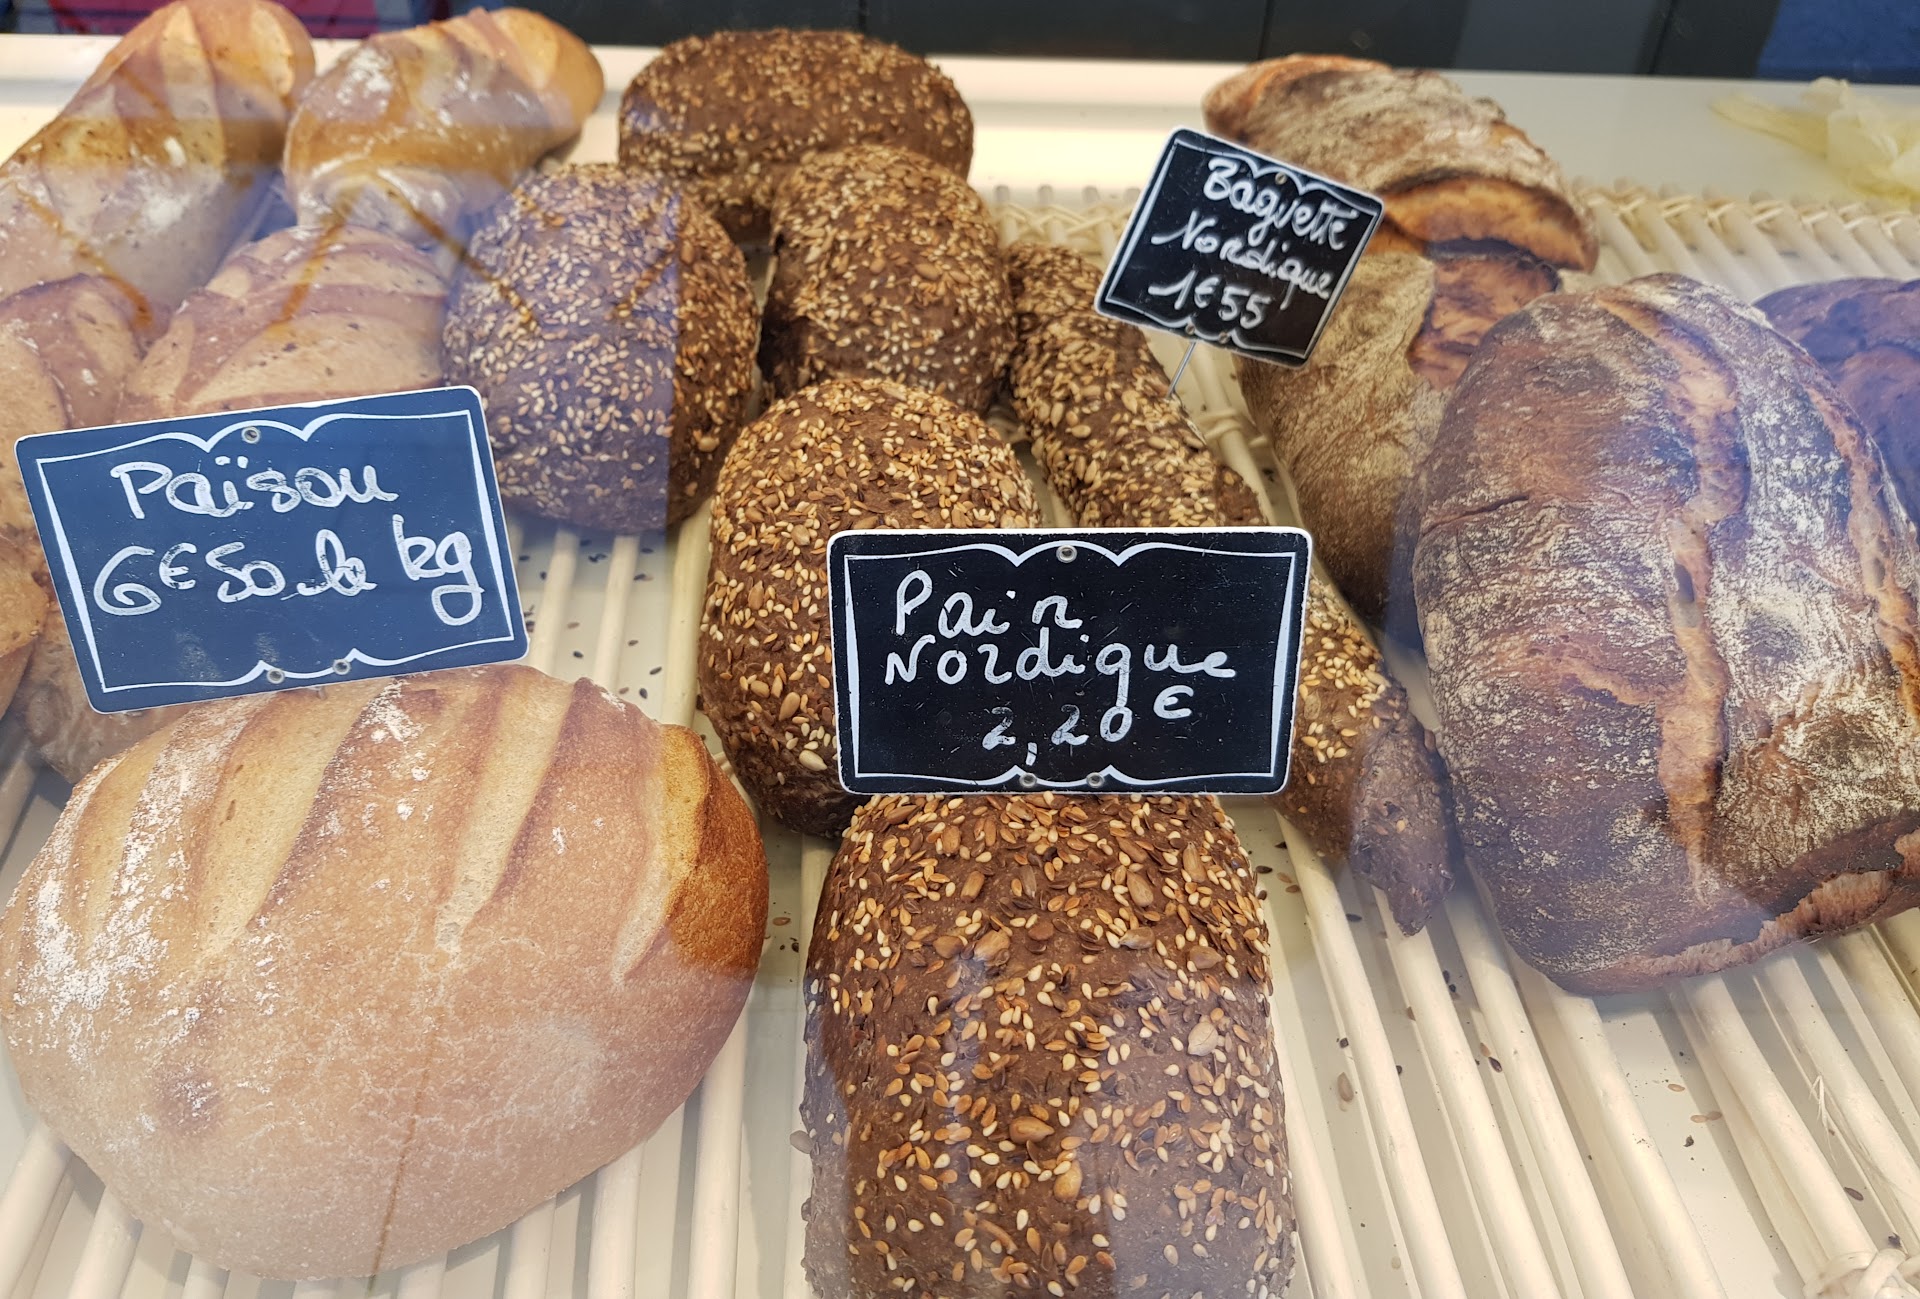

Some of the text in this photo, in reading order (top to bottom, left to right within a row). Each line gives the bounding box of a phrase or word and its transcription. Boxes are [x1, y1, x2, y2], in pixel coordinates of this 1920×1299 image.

[1148, 270, 1272, 330] 1€55
[1150, 209, 1333, 311] Nordique
[393, 514, 485, 626] kg
[895, 569, 1083, 639] Pain
[884, 626, 1237, 708] Nordique
[982, 684, 1195, 766] 2,20 €
